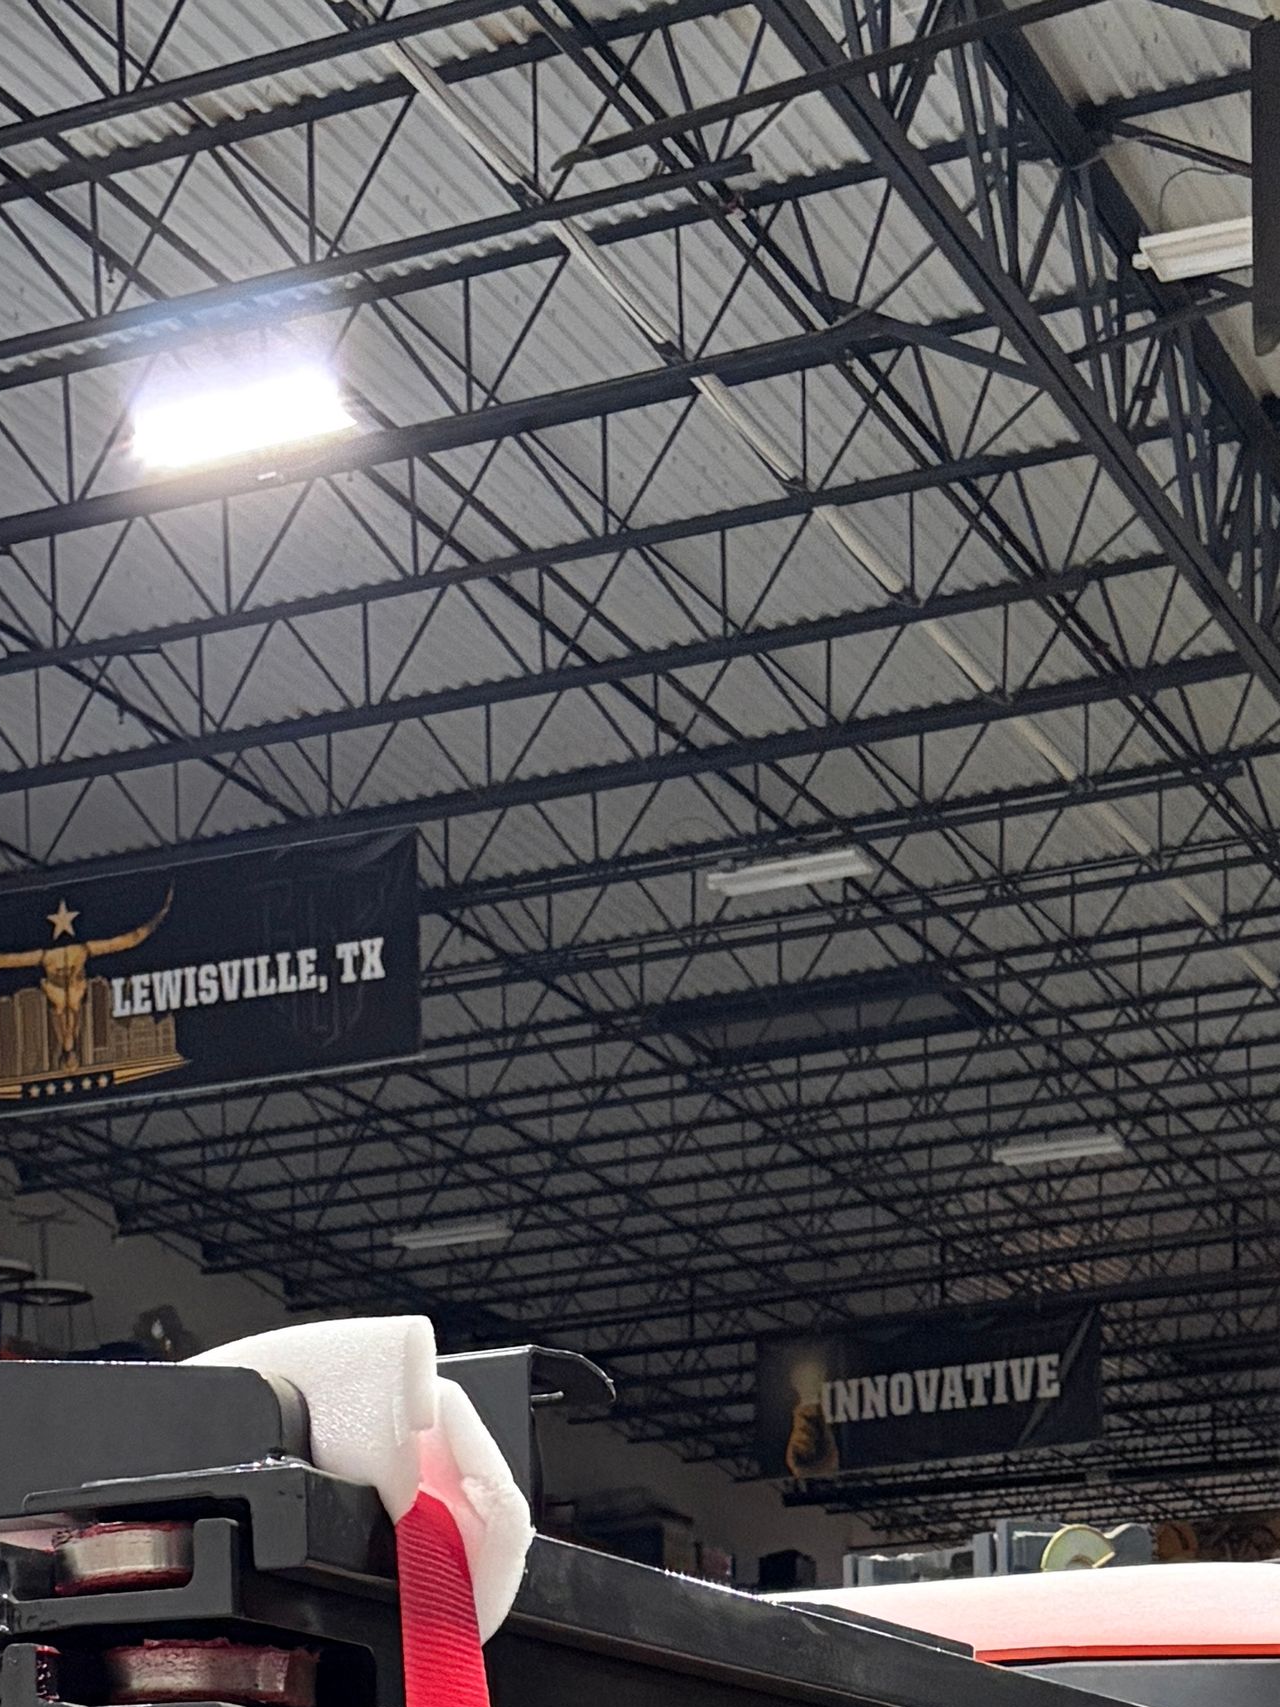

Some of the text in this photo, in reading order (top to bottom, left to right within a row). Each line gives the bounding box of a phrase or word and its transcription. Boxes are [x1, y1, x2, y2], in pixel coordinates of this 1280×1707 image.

[111, 937, 386, 1018] LEWISVILLE, TX
[821, 1353, 1060, 1424] INNOVATIVE
